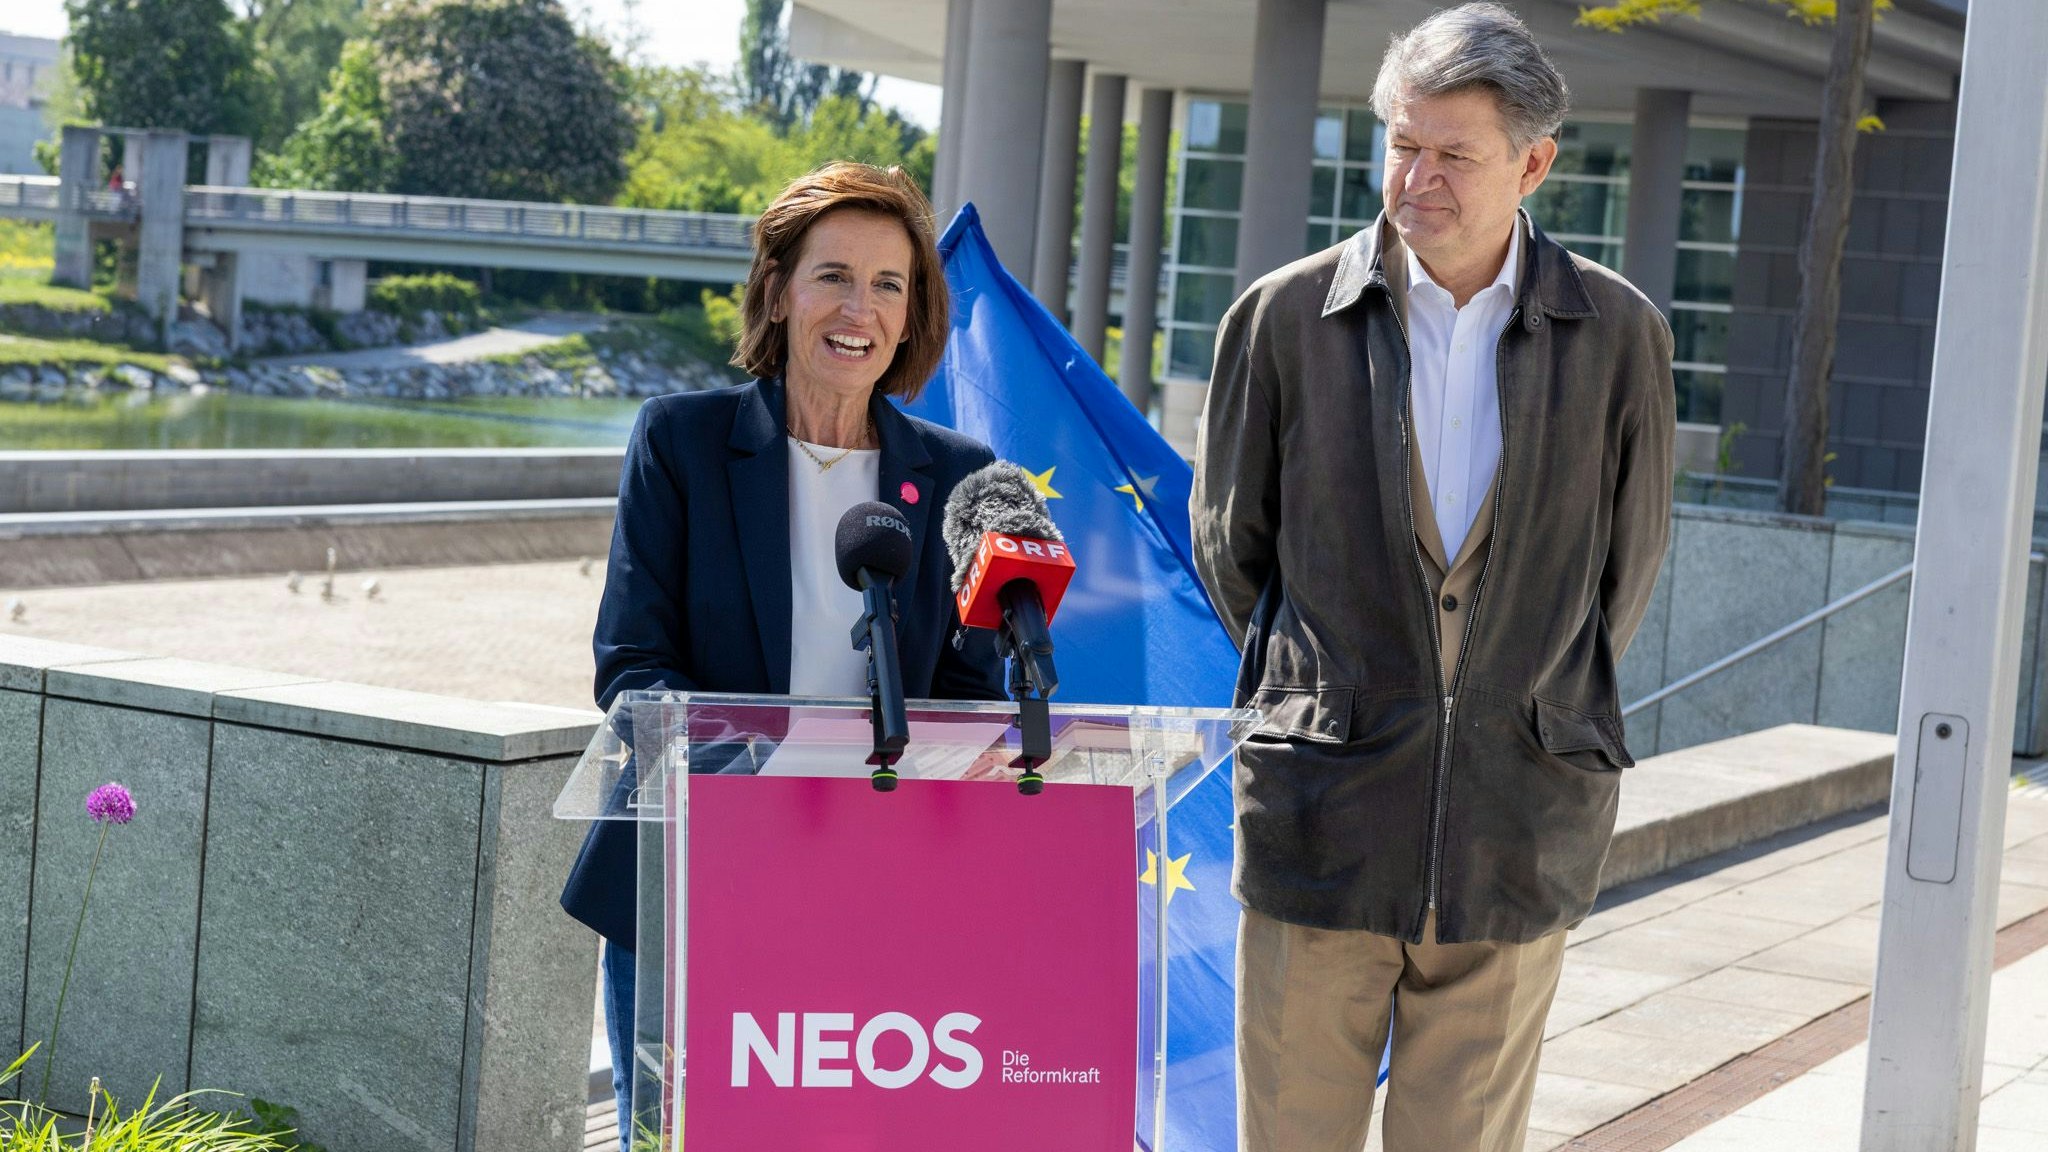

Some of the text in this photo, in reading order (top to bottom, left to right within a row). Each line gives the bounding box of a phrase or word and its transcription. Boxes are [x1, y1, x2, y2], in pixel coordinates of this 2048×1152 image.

[995, 537, 1065, 559] ORF
[961, 543, 987, 607] ORF
[731, 1012, 983, 1089] NEOS
[1002, 1050, 1030, 1066] Die
[1002, 1067, 1100, 1083] Reformkraft
